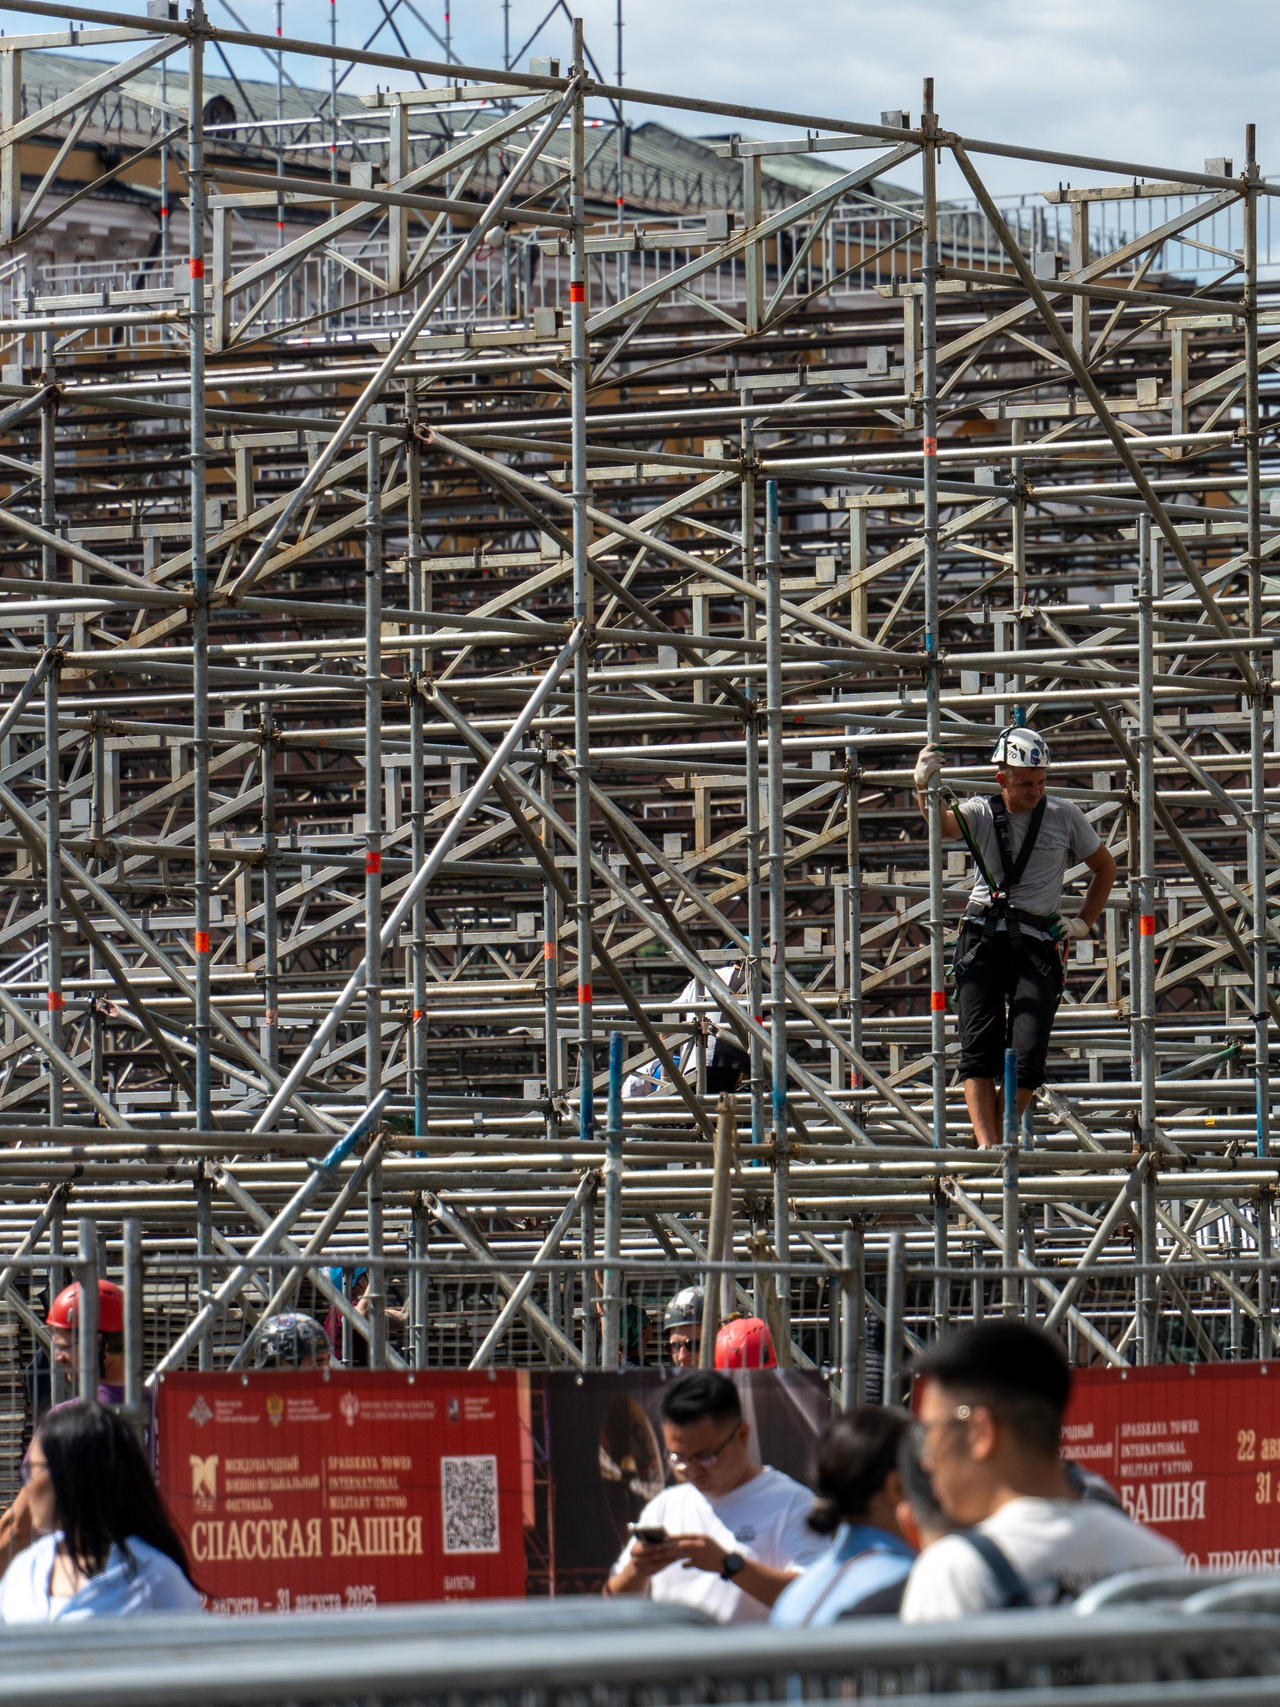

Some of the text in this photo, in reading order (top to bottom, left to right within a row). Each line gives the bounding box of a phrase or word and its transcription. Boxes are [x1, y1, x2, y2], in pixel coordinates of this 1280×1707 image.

[1121, 1419, 1200, 1437] SPASSKAYA TOWER
[1121, 1441, 1186, 1458] INTERNATIONAL
[1237, 1429, 1256, 1462] 22
[225, 1455, 299, 1473] МЕЖДУНАРОДНЫЙ
[328, 1455, 413, 1470] SPASSKAYA TOWER
[1121, 1460, 1193, 1478] MILITARY TATTOO
[328, 1475, 399, 1490] INTERNATIONAL
[1255, 1471, 1272, 1504] 31
[225, 1498, 273, 1512] ФЕСТИВАЛЬ
[329, 1495, 407, 1510] MILITARY TATTOO
[1120, 1480, 1207, 1524] БАШНЯ
[191, 1516, 423, 1561] СПАССКАЯ БАШНЯ
[443, 1576, 476, 1591] БИЛЕТЫ
[277, 1588, 290, 1613] 31
[345, 1584, 377, 1611] 2025
